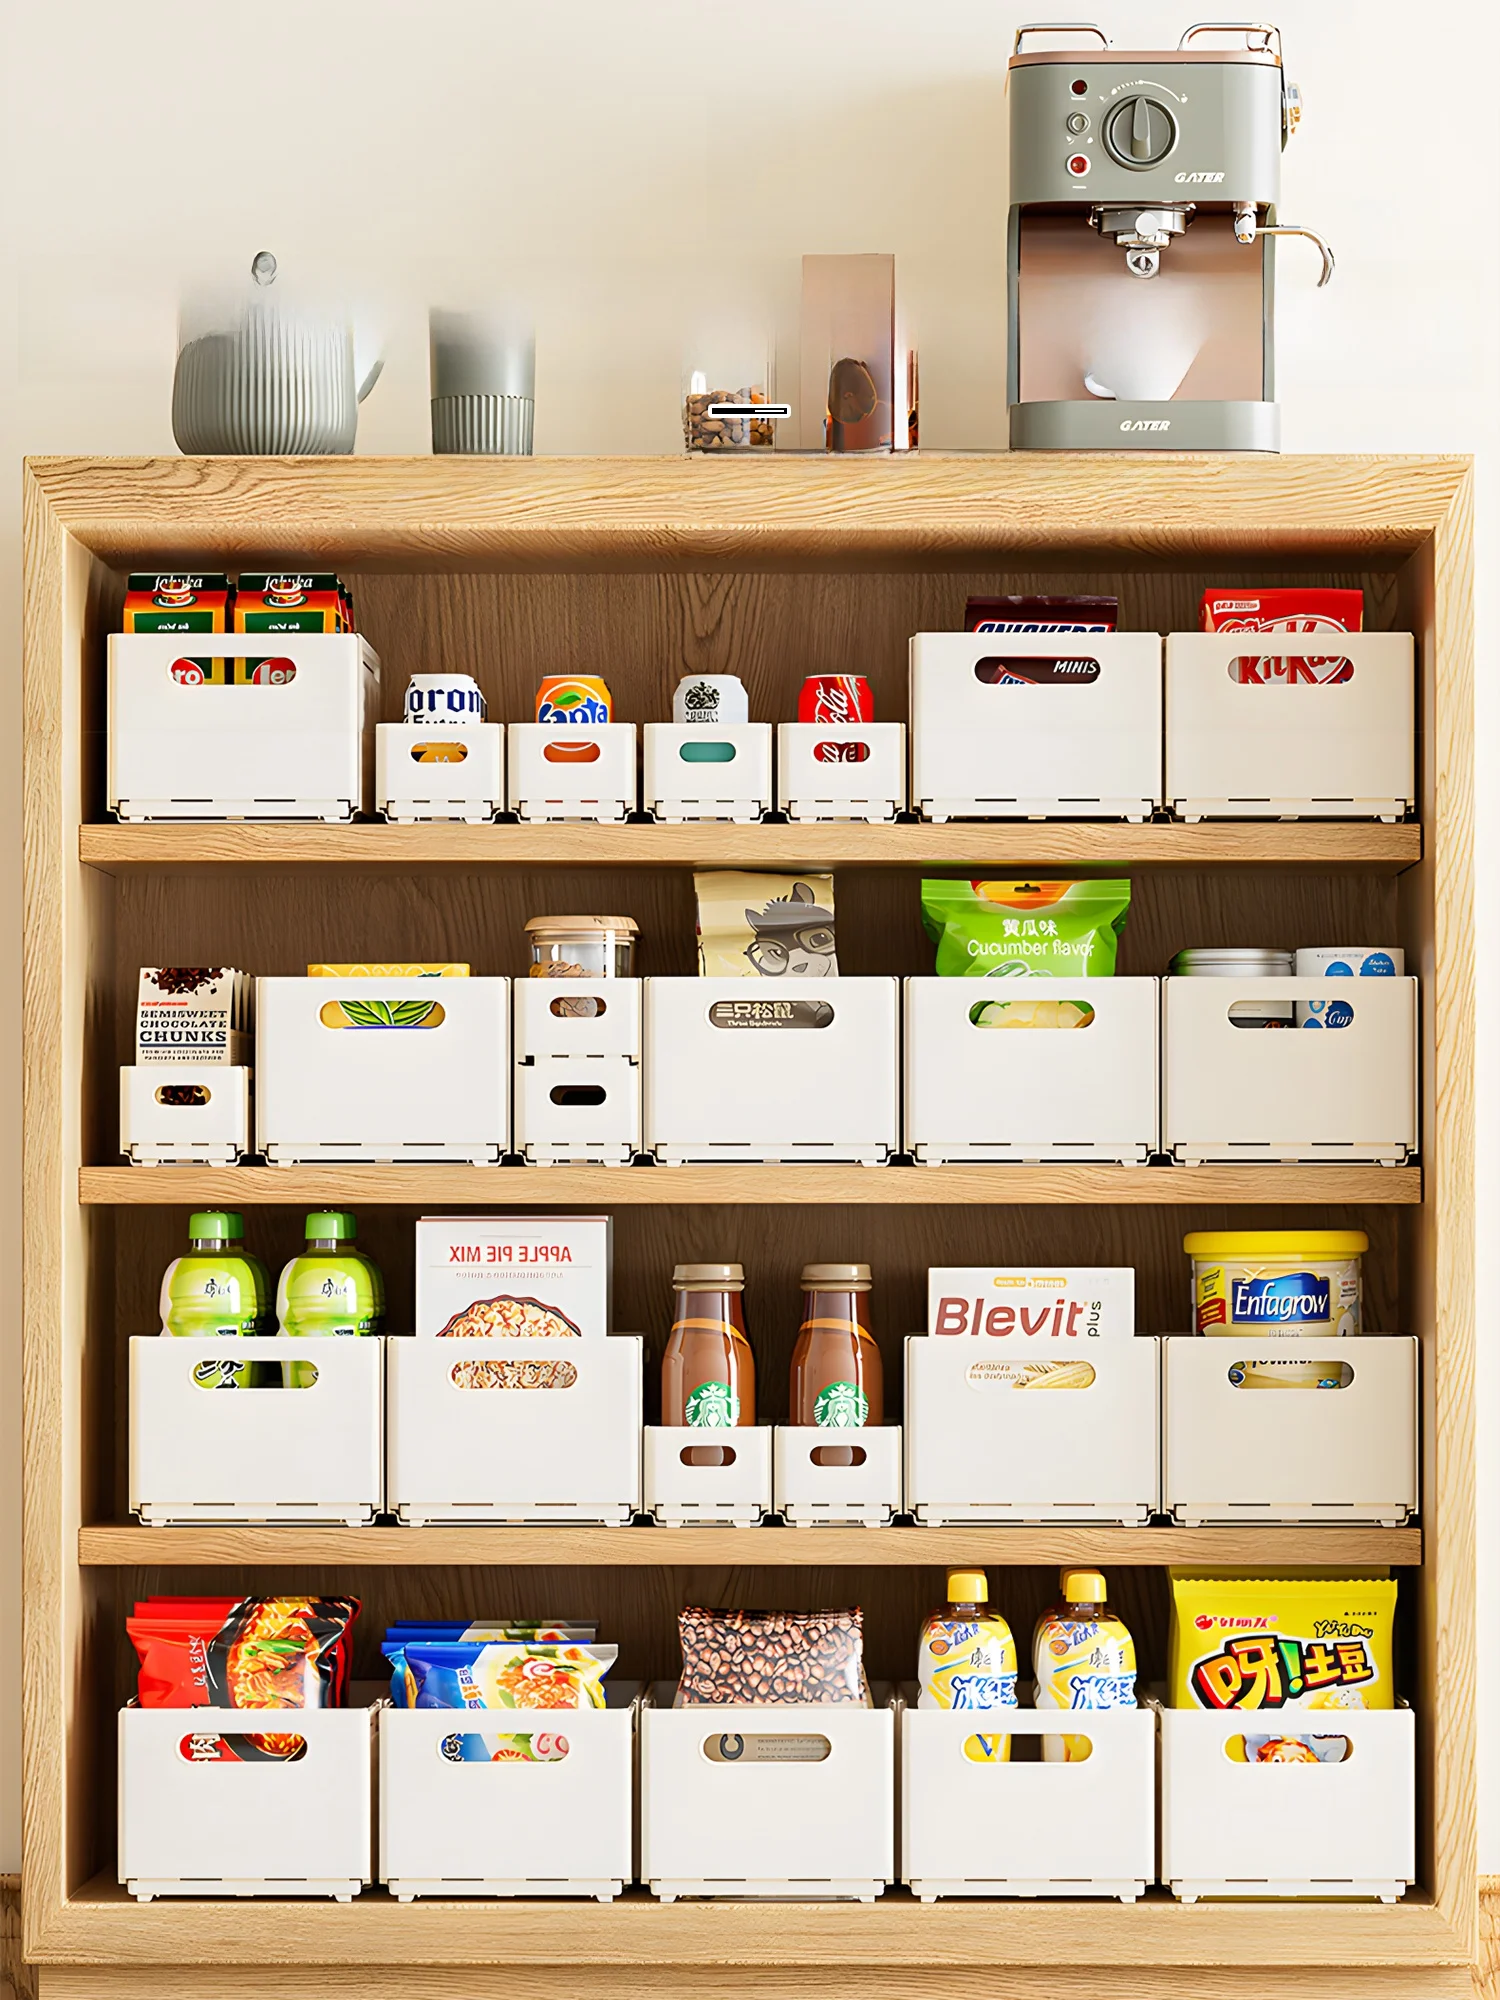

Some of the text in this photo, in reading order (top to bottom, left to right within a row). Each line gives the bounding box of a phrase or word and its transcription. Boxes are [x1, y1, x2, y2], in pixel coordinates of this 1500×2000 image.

[1174, 172, 1225, 183] GATER
[1120, 420, 1171, 432] GATER
[1053, 661, 1097, 674] MINIS
[1002, 919, 1059, 937] 黄瓜味
[967, 939, 1095, 957] Cucumber flavor
[716, 1002, 794, 1019] 三只松鼠
[140, 1020, 227, 1029] CHOCOLATE
[140, 1031, 227, 1042] CHUNKS
[1235, 1283, 1328, 1321] Enfagrow
[935, 1298, 1084, 1337] Blevit
[1087, 1301, 1102, 1337] plus
